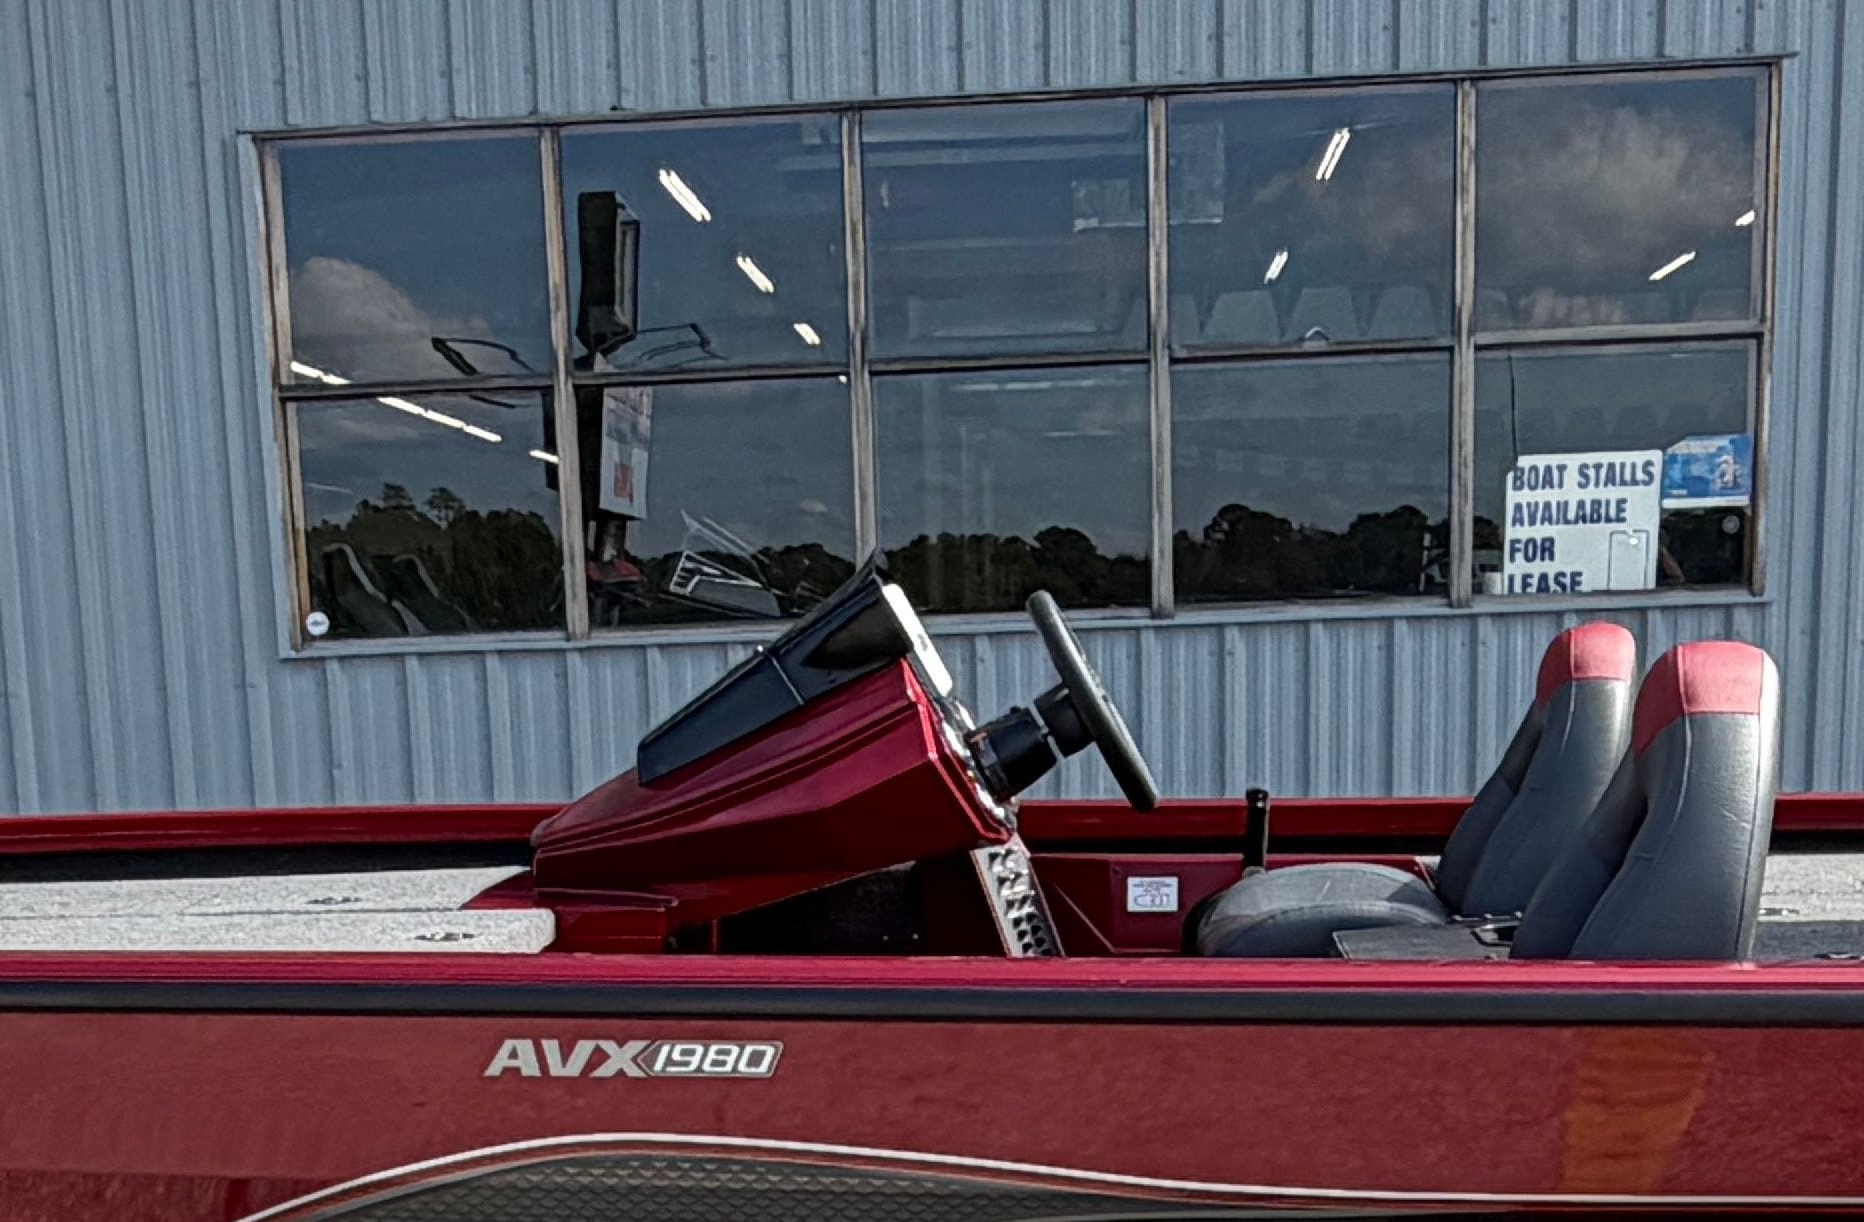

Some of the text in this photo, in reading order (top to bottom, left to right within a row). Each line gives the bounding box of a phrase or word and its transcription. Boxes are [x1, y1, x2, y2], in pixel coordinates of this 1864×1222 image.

[1511, 459, 1655, 492] BOAT STALLS
[1511, 498, 1628, 527] AVAILABLE
[1509, 536, 1555, 563] FOR
[1507, 570, 1583, 593] LEASE
[483, 1038, 776, 1077] AVX 1980
